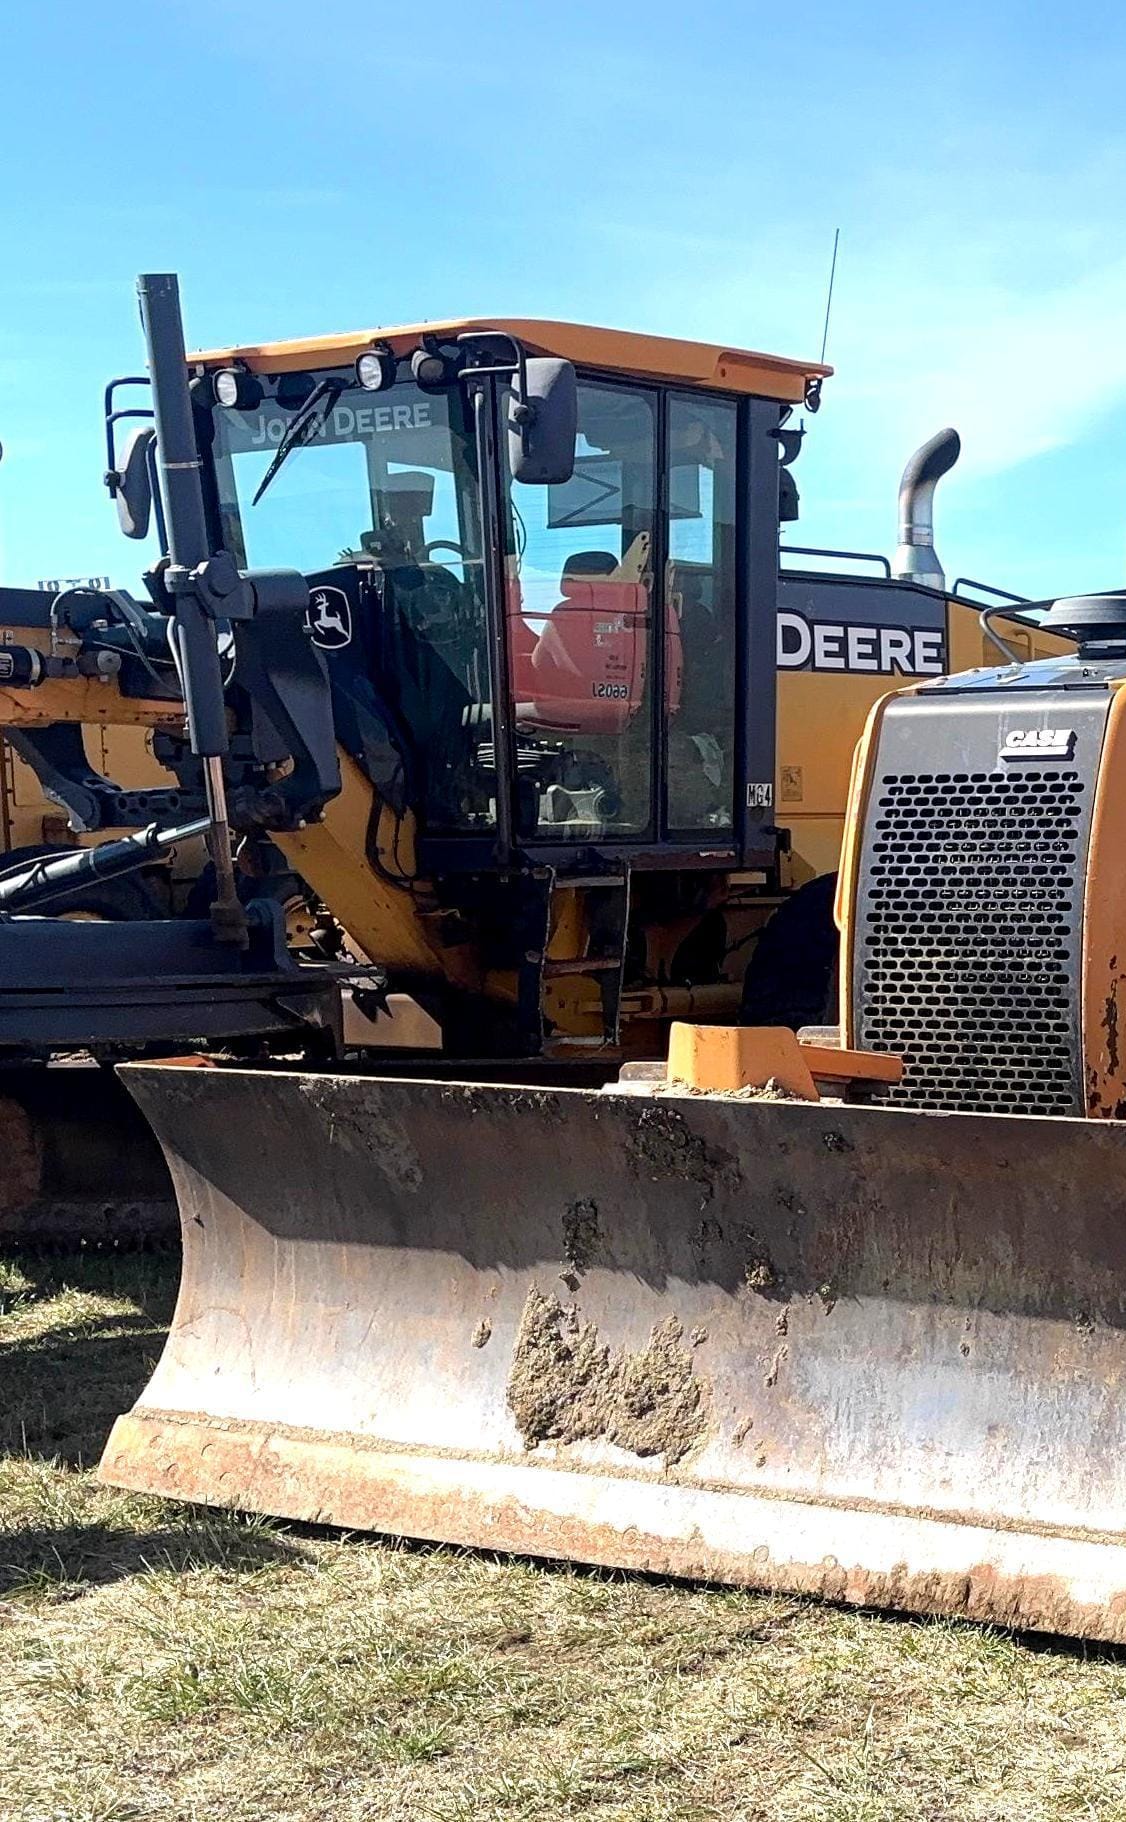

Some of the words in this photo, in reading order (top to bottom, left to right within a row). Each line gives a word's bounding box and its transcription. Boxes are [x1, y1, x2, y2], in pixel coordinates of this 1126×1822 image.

[333, 403, 432, 436] DEERE
[776, 612, 944, 674] DEERE
[1005, 729, 1073, 749] CASE
[747, 784, 771, 806] MG4
